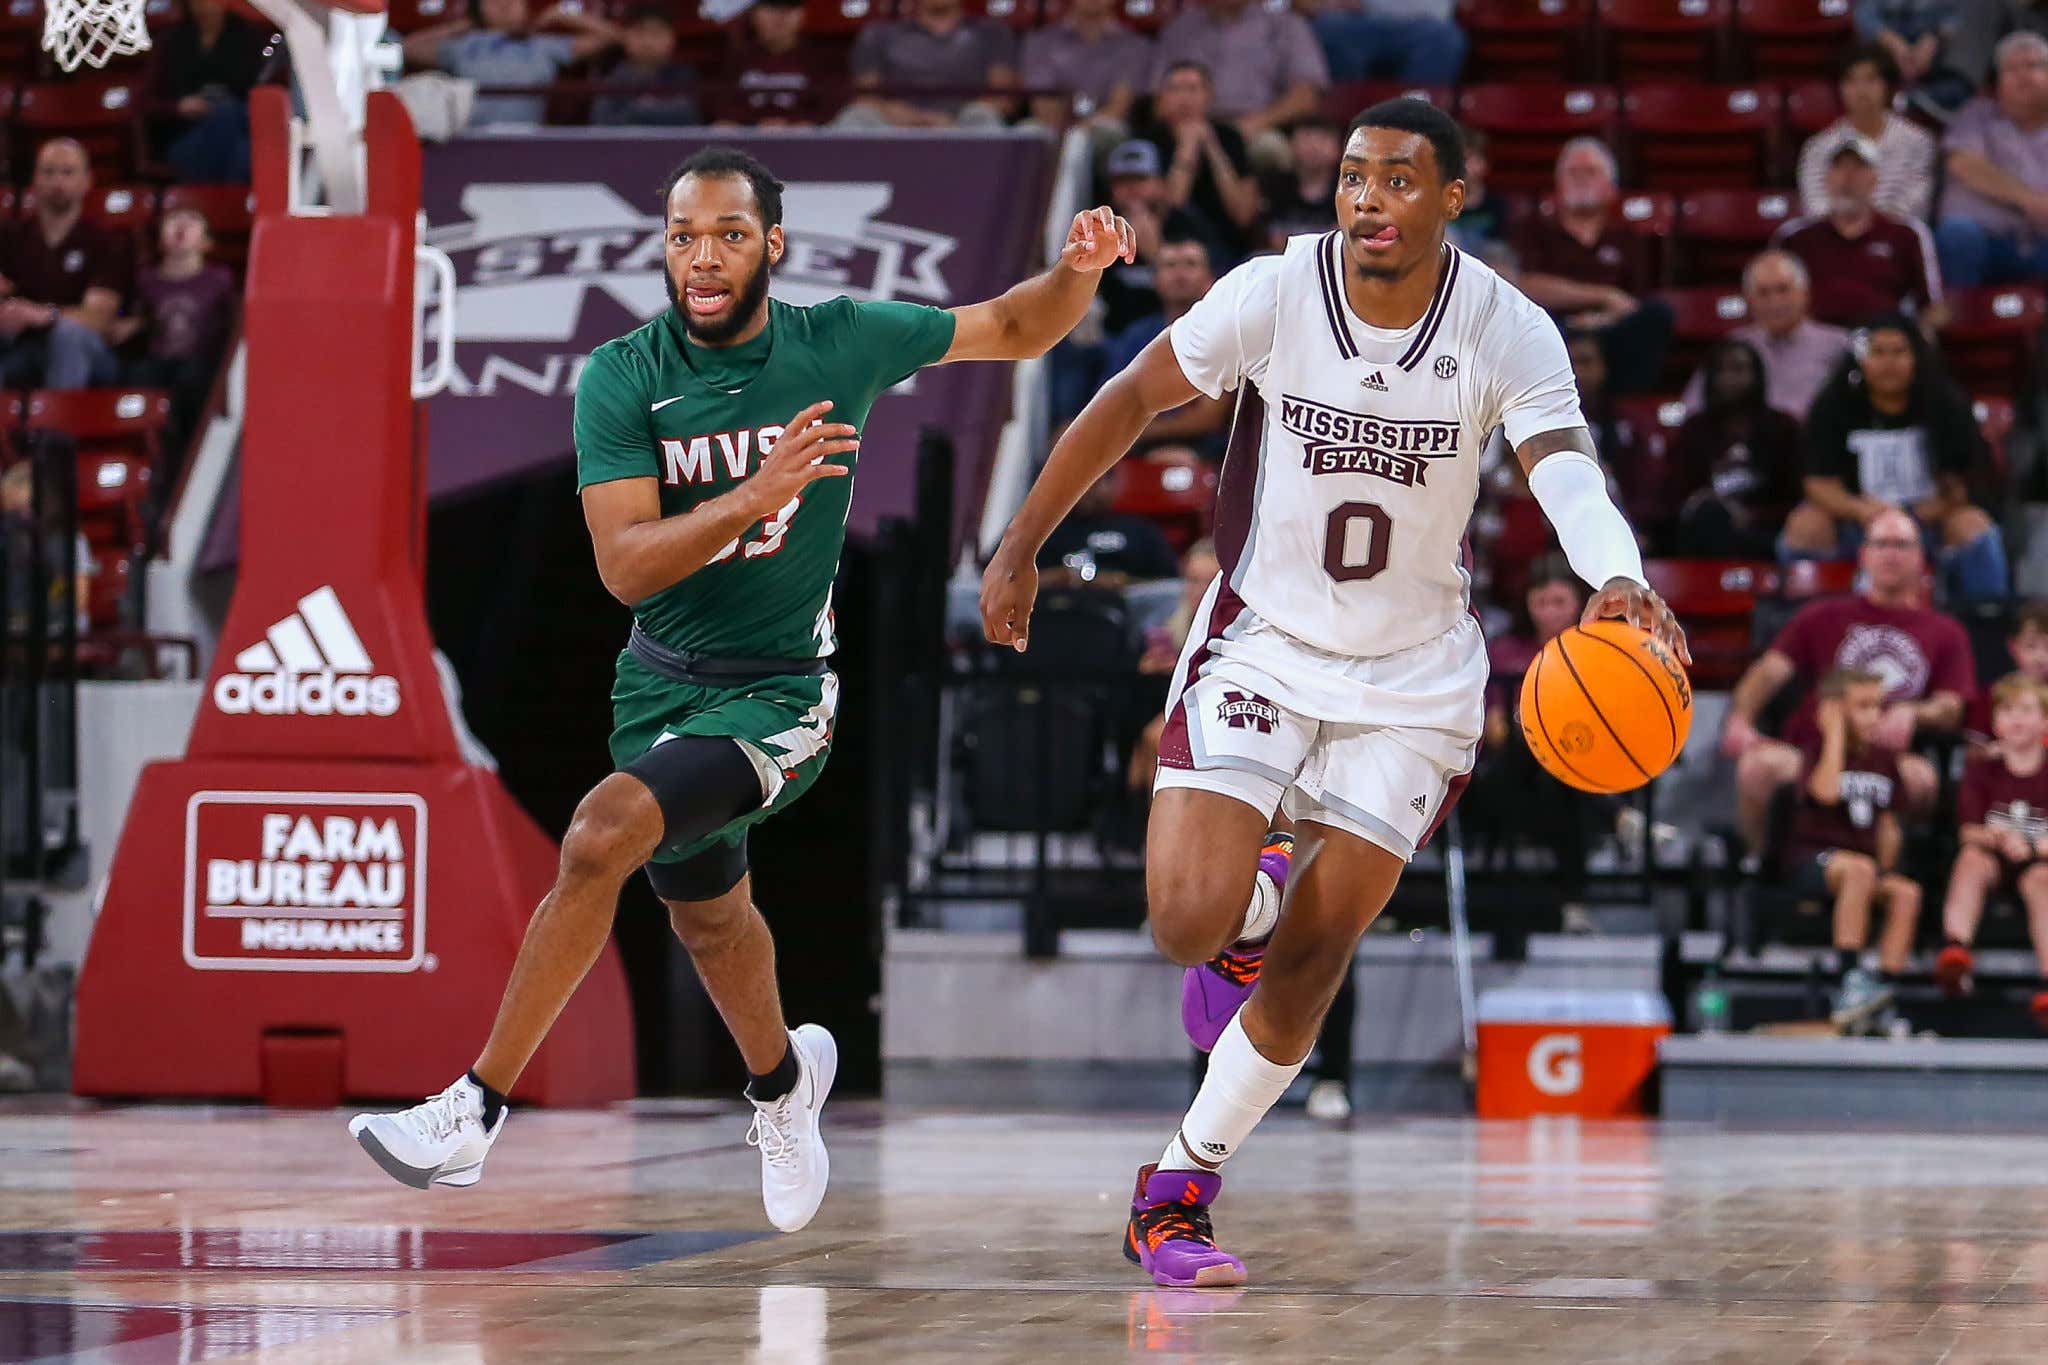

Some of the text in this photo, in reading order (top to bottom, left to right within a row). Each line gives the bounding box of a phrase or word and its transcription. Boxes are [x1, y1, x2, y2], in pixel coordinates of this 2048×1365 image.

[1361, 381, 1389, 392] adidas
[1436, 357, 1457, 378] SEC
[1281, 400, 1460, 452] MISSISSIPPI
[1321, 450, 1406, 481] STATE
[1323, 501, 1392, 582] 0
[214, 665, 401, 716] adidas
[1229, 702, 1270, 718] STATE
[262, 814, 404, 861] FARM
[207, 859, 406, 907] BUREAU
[241, 919, 405, 951] INSURANCE
[1527, 1033, 1583, 1096] G
